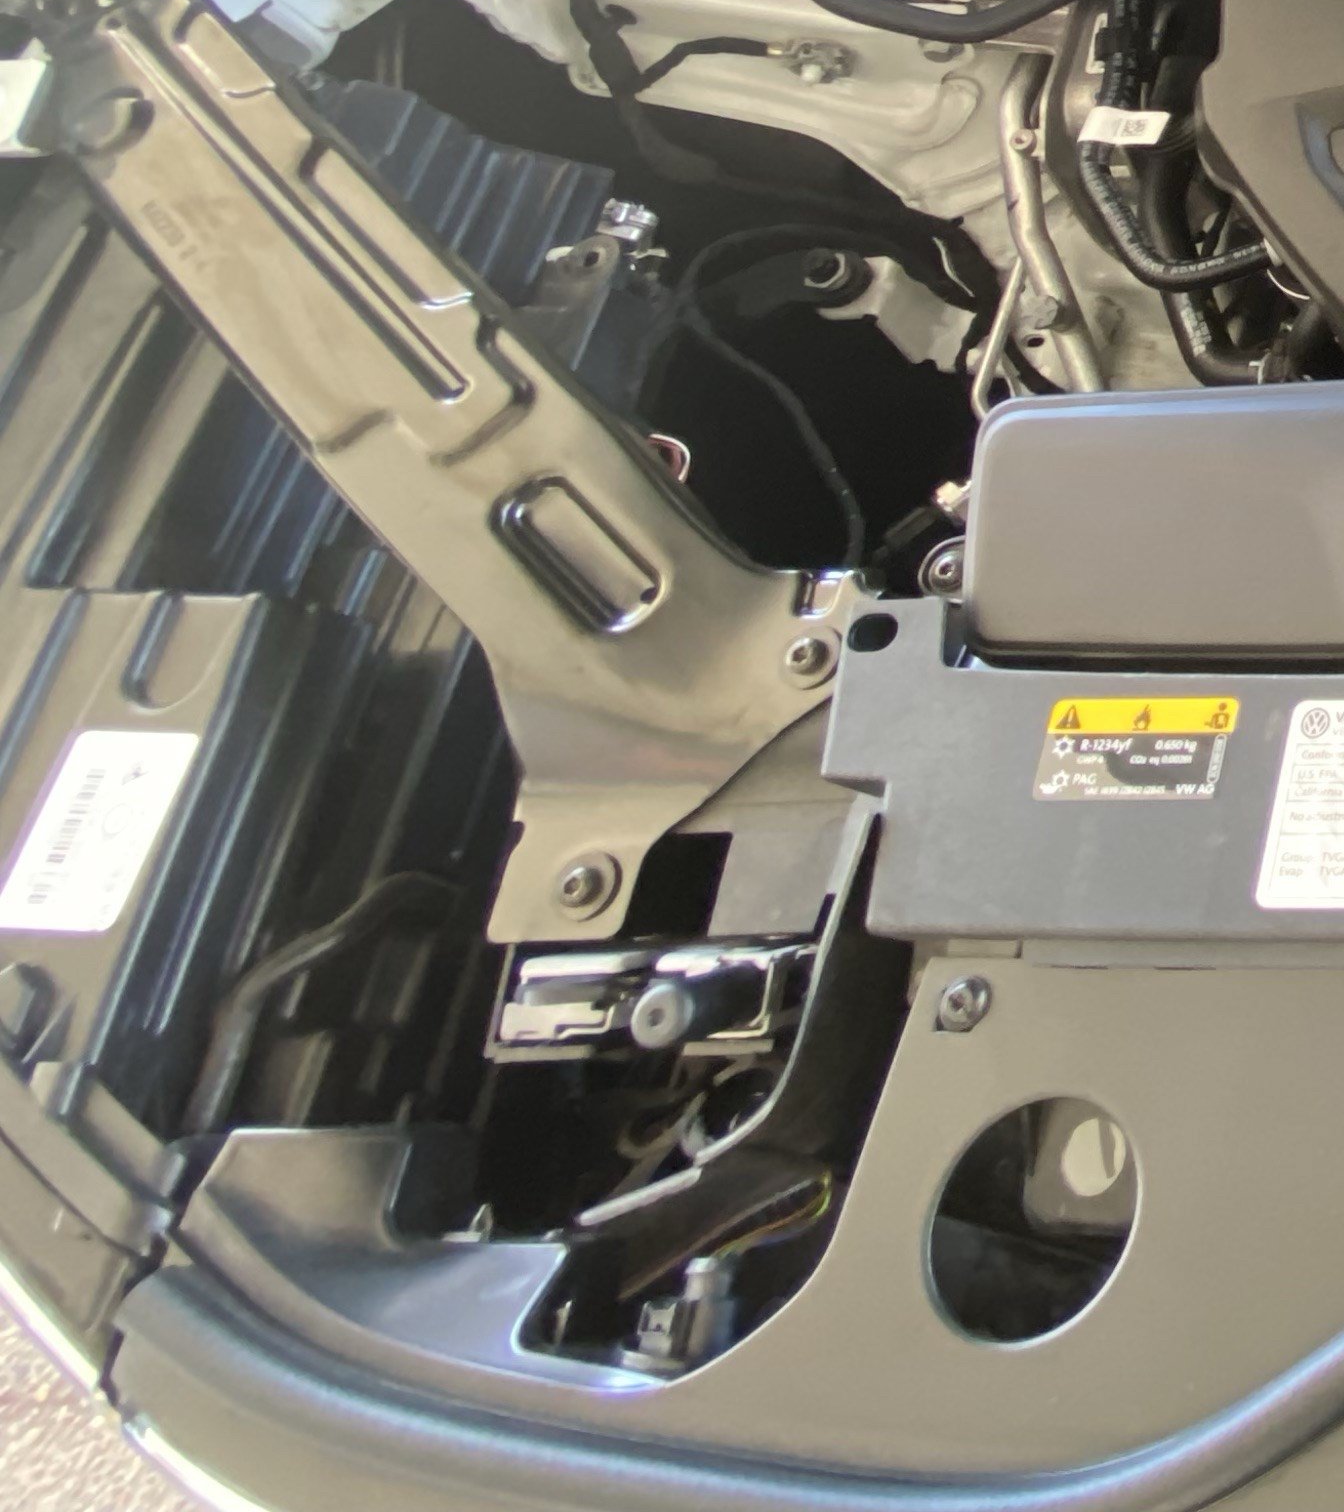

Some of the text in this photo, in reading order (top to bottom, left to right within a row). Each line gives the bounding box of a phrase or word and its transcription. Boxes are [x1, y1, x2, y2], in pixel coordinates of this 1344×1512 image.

[1080, 738, 1198, 755] R-1234yf 0.650 kg
[1072, 773, 1097, 786] PAG
[1176, 784, 1197, 795] VW
[1198, 784, 1215, 795] AG
[1290, 812, 1304, 821] No
